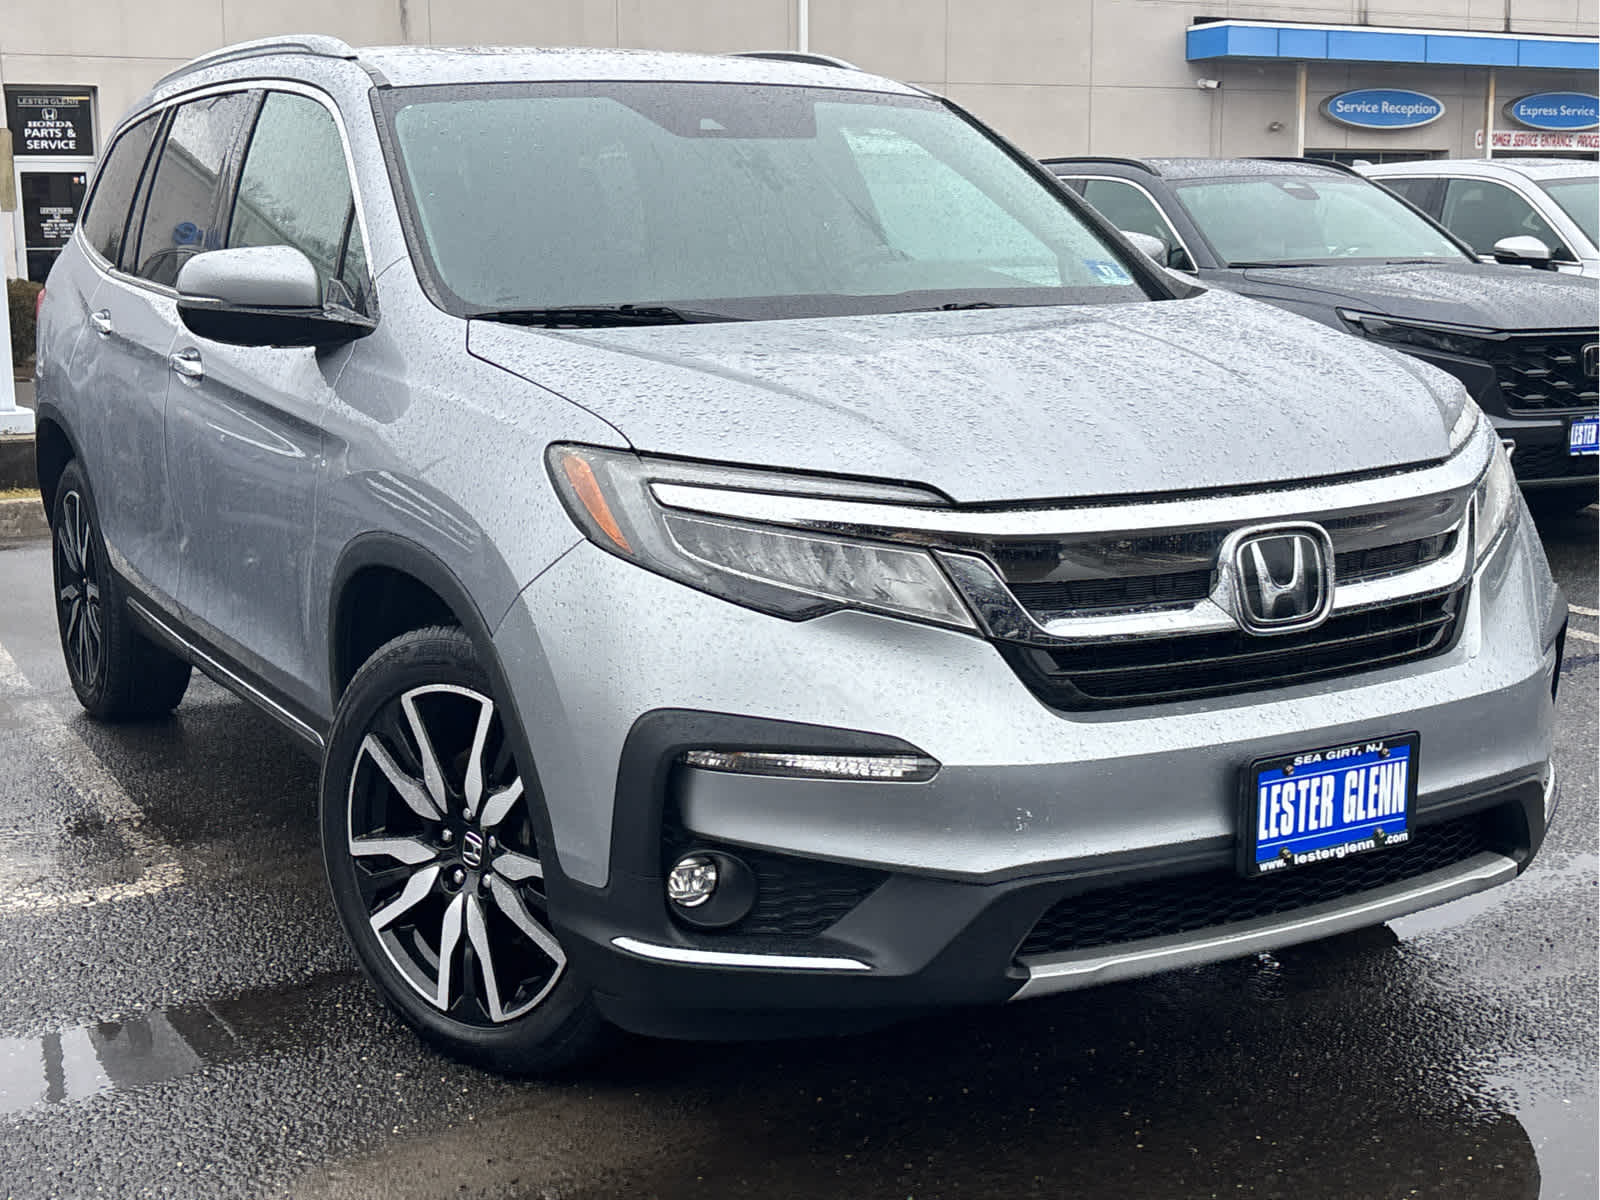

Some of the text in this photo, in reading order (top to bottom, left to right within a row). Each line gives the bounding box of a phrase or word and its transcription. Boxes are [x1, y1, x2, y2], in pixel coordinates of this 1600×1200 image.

[17, 97, 49, 105] LESTER
[1336, 100, 1437, 117] Service Reception
[1520, 105, 1595, 118] Express Service
[24, 128, 77, 138] PARTS &
[1513, 133, 1538, 147] SERVICE
[26, 140, 77, 150] SERVICE
[1570, 424, 1597, 445] LESTER
[1293, 742, 1384, 766] SEA GIRT, NJ
[1258, 761, 1408, 841] LESTER GLENN
[1259, 832, 1409, 872] www. lesterglenn .com
